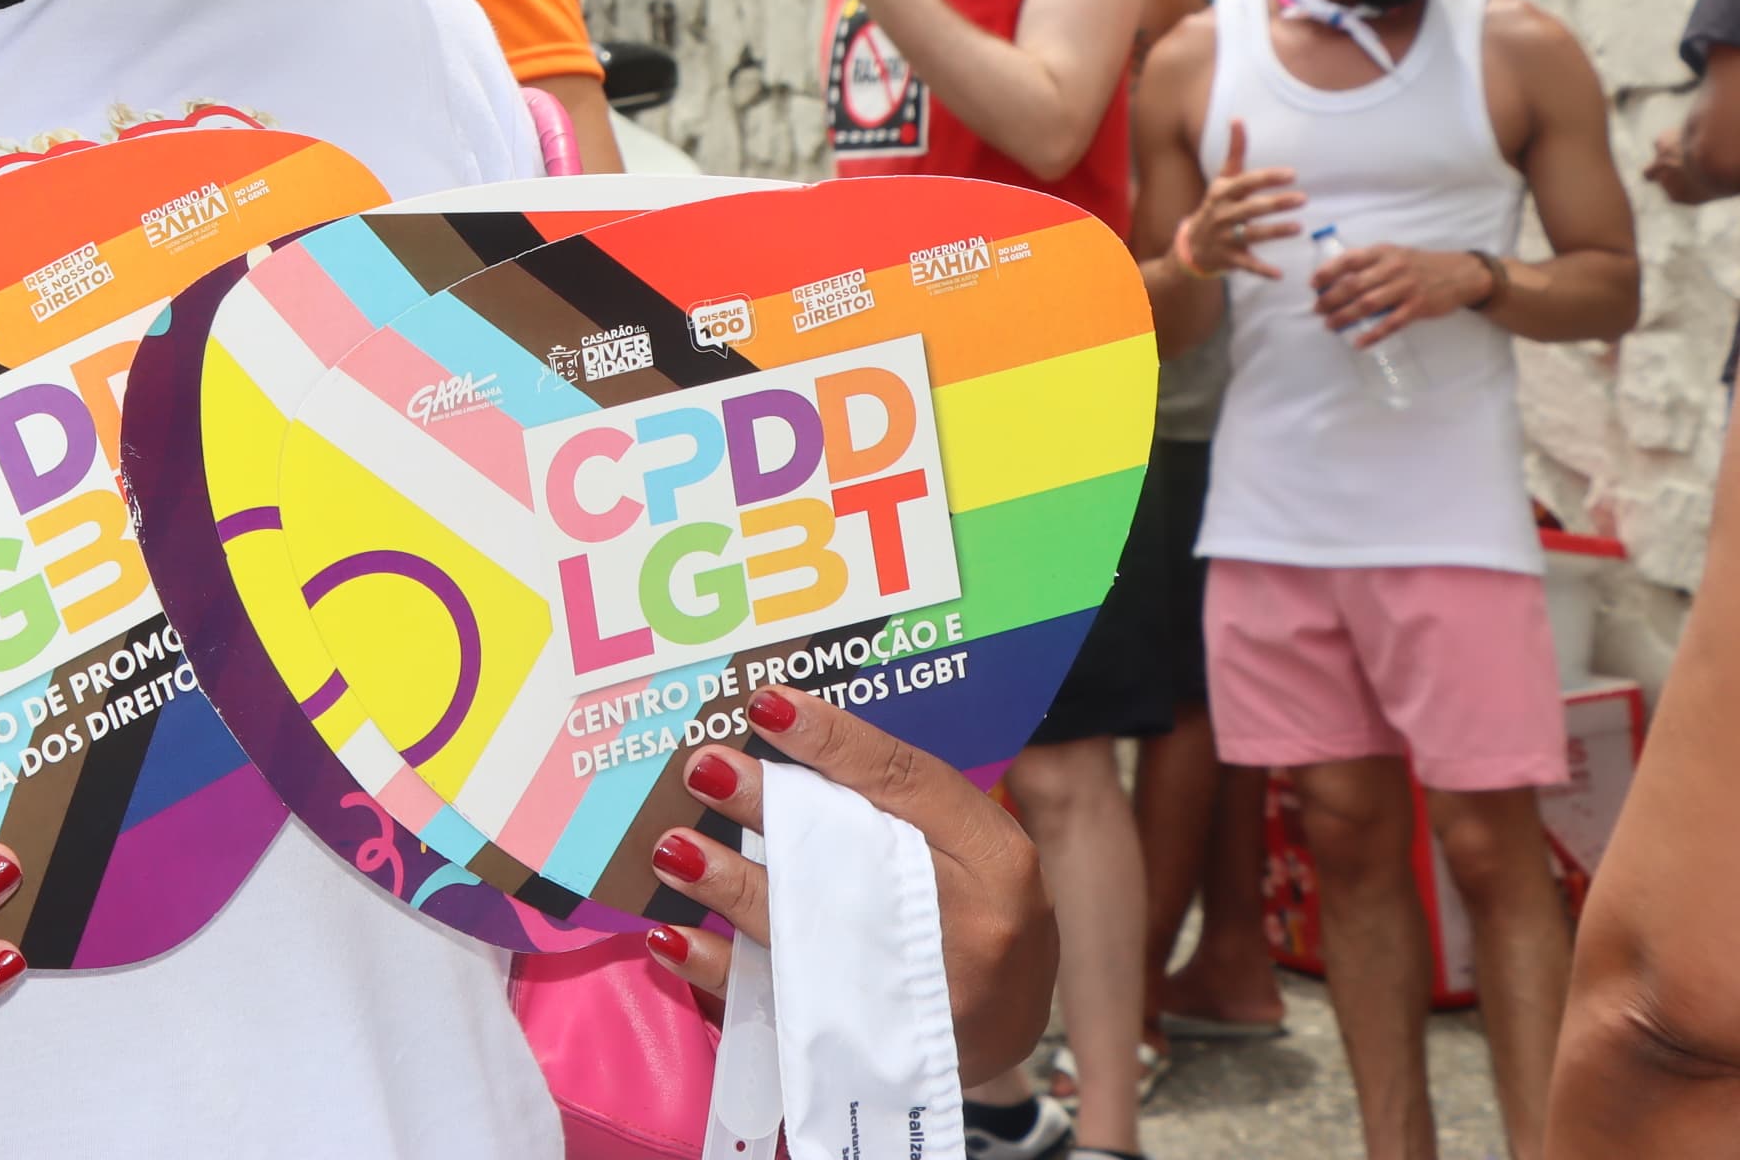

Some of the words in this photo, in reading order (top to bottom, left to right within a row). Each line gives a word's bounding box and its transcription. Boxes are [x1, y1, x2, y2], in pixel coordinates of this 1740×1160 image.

[141, 190, 200, 225] GOVERNO
[201, 182, 221, 197] DA
[234, 187, 246, 198] DO
[245, 179, 266, 193] LADO
[237, 197, 248, 207] DA
[248, 186, 270, 200] GENTE
[144, 195, 227, 247] BAHIA
[25, 245, 95, 289] RESPEITO
[909, 240, 967, 264] GOVERNO
[969, 236, 986, 249] DA
[911, 247, 990, 284] BAHIA
[998, 247, 1009, 256] DO
[1011, 242, 1029, 252] LADO
[1000, 255, 1011, 264] DA
[1010, 250, 1032, 261] GENTE
[33, 266, 112, 319] DIREITO!
[41, 285, 51, 297] É
[52, 260, 94, 290] NOSSO
[794, 271, 862, 301] RESPEITO
[817, 284, 859, 306] NOSSO
[699, 307, 745, 323] DISQUE
[699, 317, 745, 340] 100
[795, 293, 873, 330] DIREITO!
[581, 324, 634, 347] CASARÃO
[634, 324, 646, 335] da
[582, 333, 650, 368] DIVER
[586, 352, 654, 381] SIDADE
[406, 371, 498, 426] GAPA
[474, 385, 503, 401] BAHIA
[545, 366, 917, 543] CPDD
[557, 469, 929, 676] LGBT
[566, 681, 689, 738] CENTRO
[696, 668, 739, 703] DE
[747, 617, 938, 691] PROMOÇÃO
[944, 613, 964, 641] E
[22, 685, 68, 728] DE
[572, 726, 679, 778] DEFESA
[684, 707, 748, 747] DOS
[895, 651, 969, 694] LGBT
[19, 724, 84, 778] DOS
